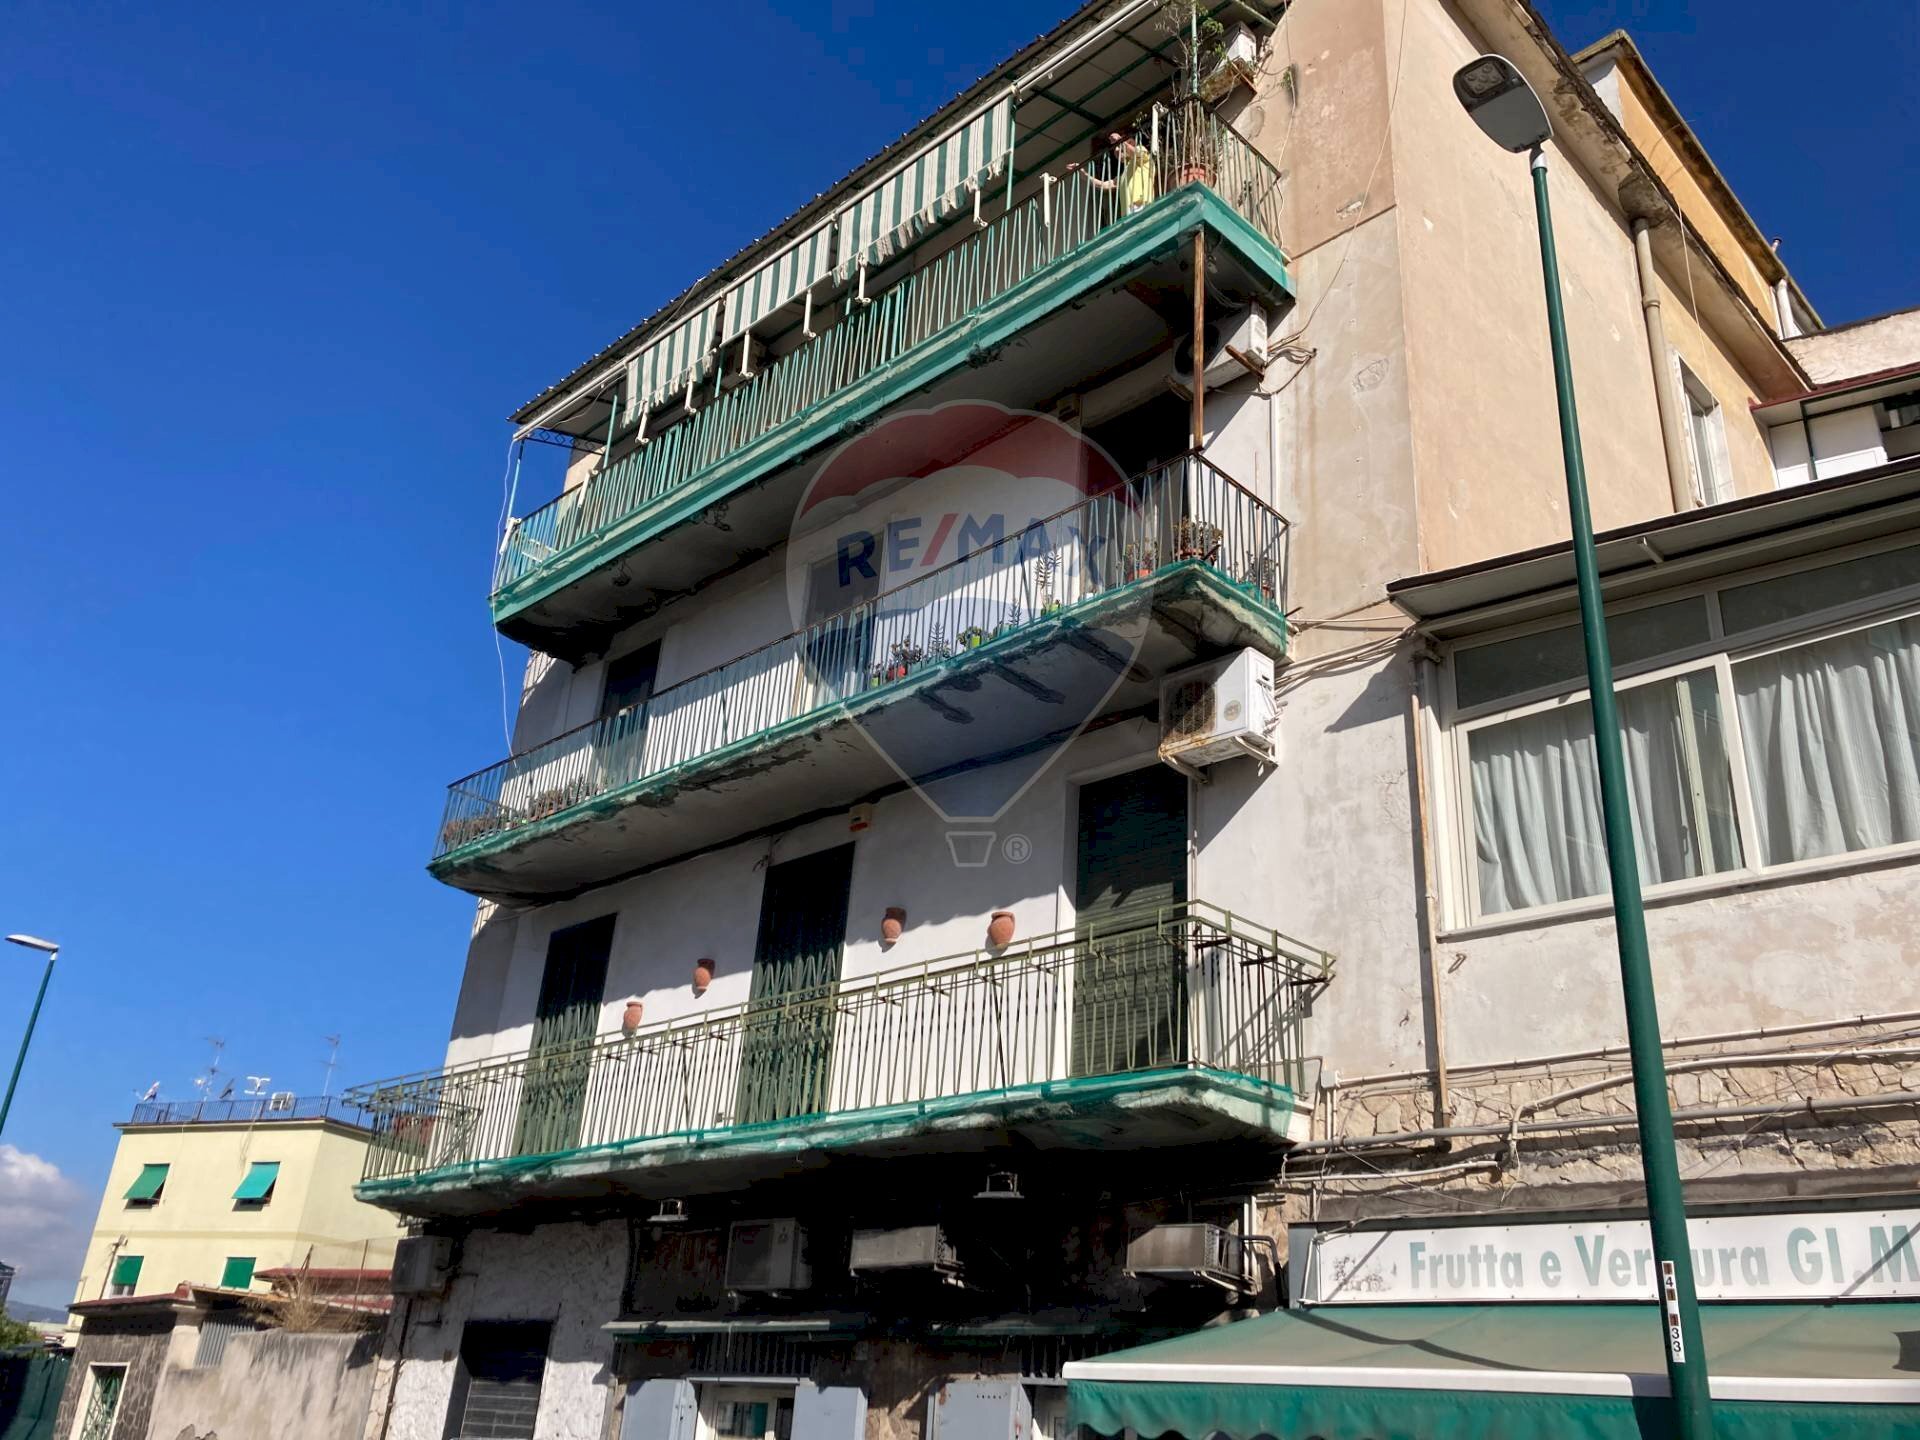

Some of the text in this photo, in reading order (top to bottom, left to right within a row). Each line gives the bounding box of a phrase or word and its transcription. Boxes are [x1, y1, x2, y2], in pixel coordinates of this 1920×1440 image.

[1409, 1241, 1525, 1288] Frutta
[1539, 1249, 1562, 1287] e
[1574, 1234, 1770, 1288] Verura
